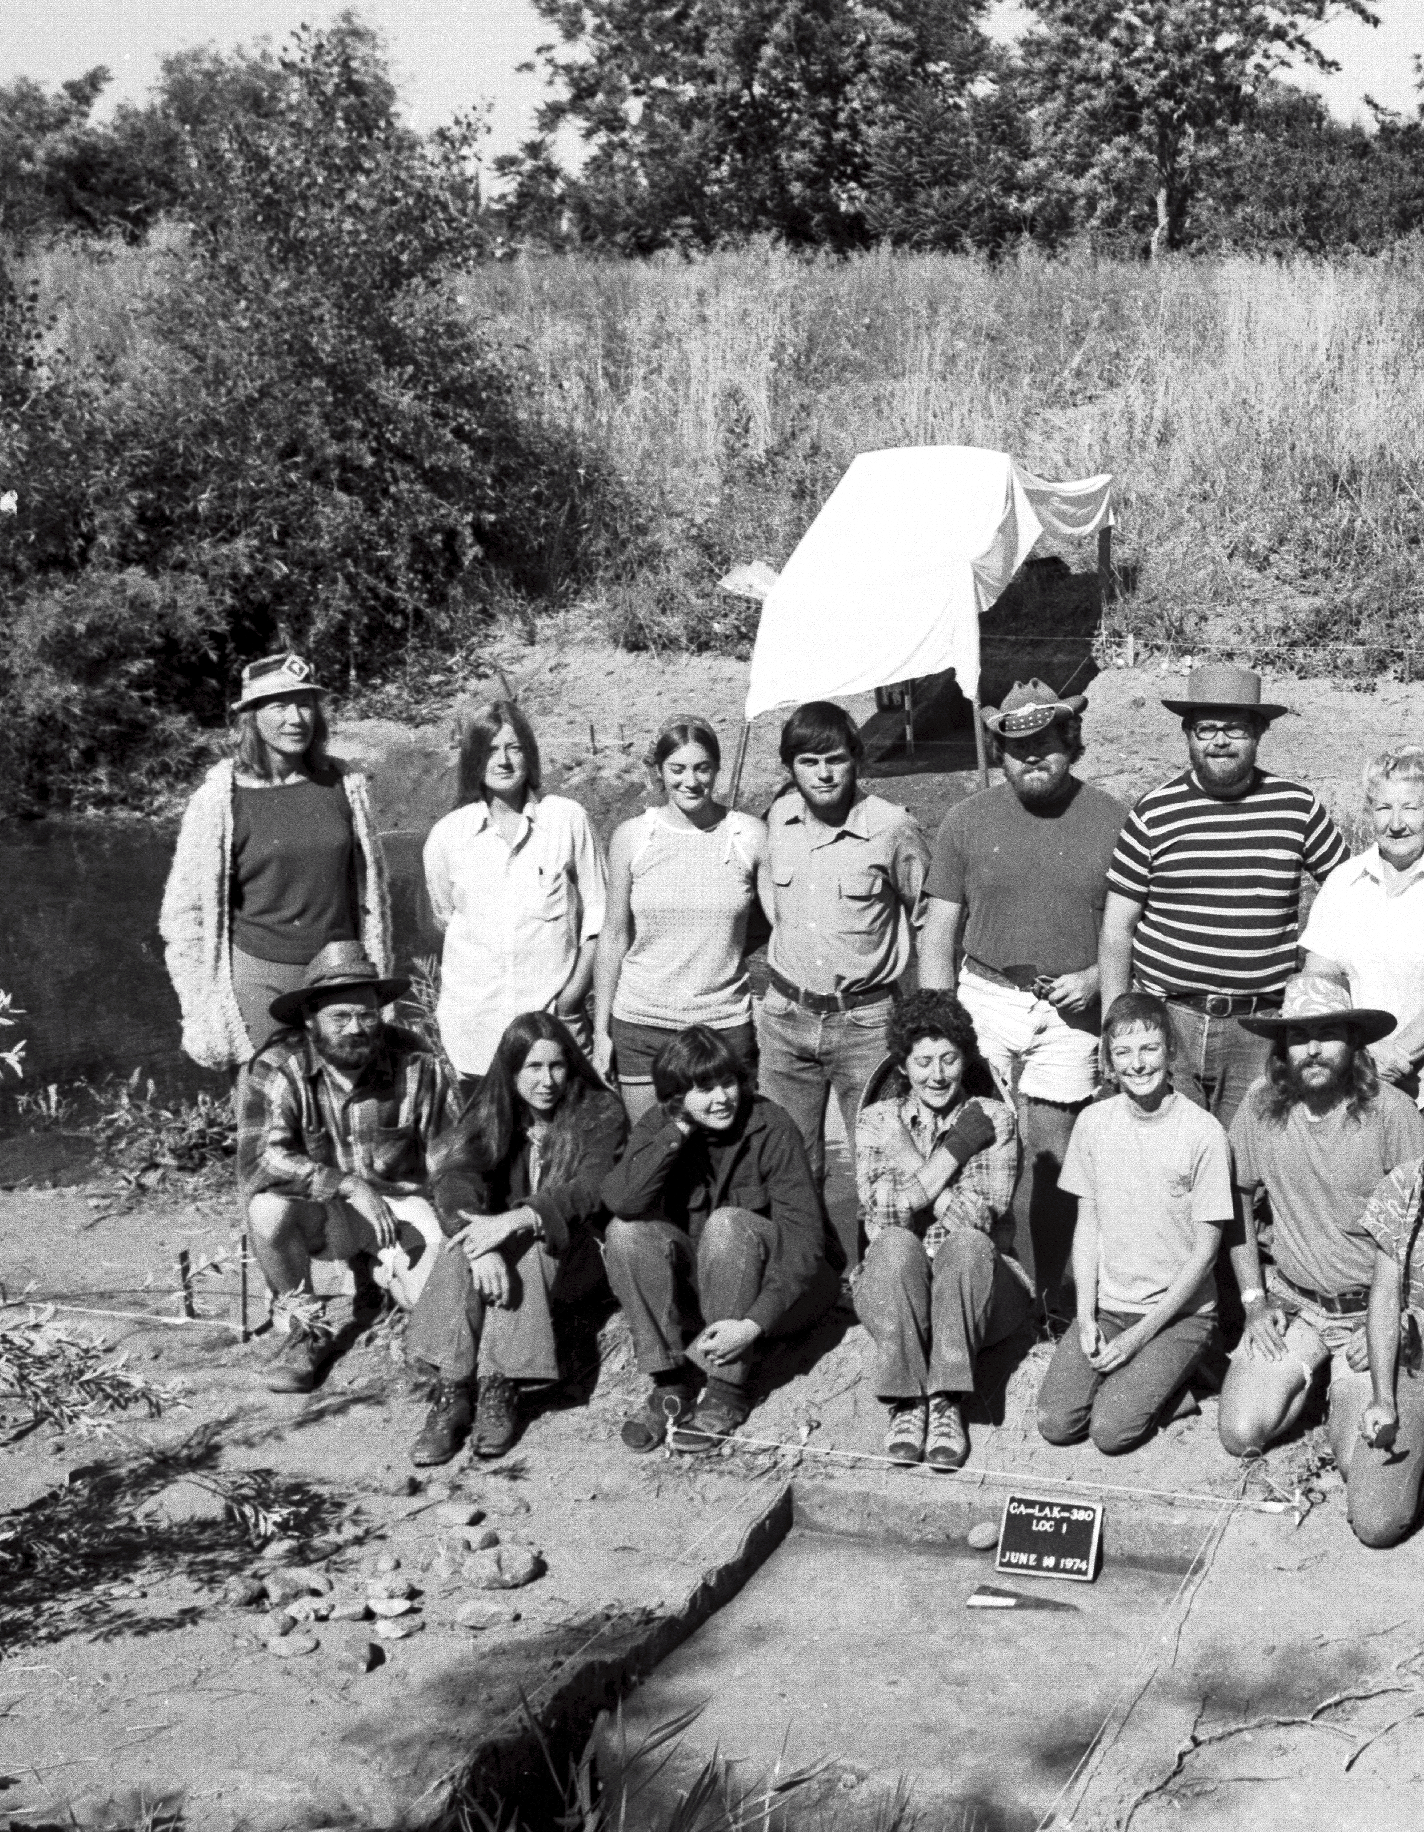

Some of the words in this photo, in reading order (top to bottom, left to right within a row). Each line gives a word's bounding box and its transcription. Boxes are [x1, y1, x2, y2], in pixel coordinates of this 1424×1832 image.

[1009, 1502, 1094, 1521] CA-LAK-380
[1031, 1519, 1055, 1532] LOC
[1001, 1551, 1037, 1566] JUNE
[1059, 1557, 1088, 1572] 1974
